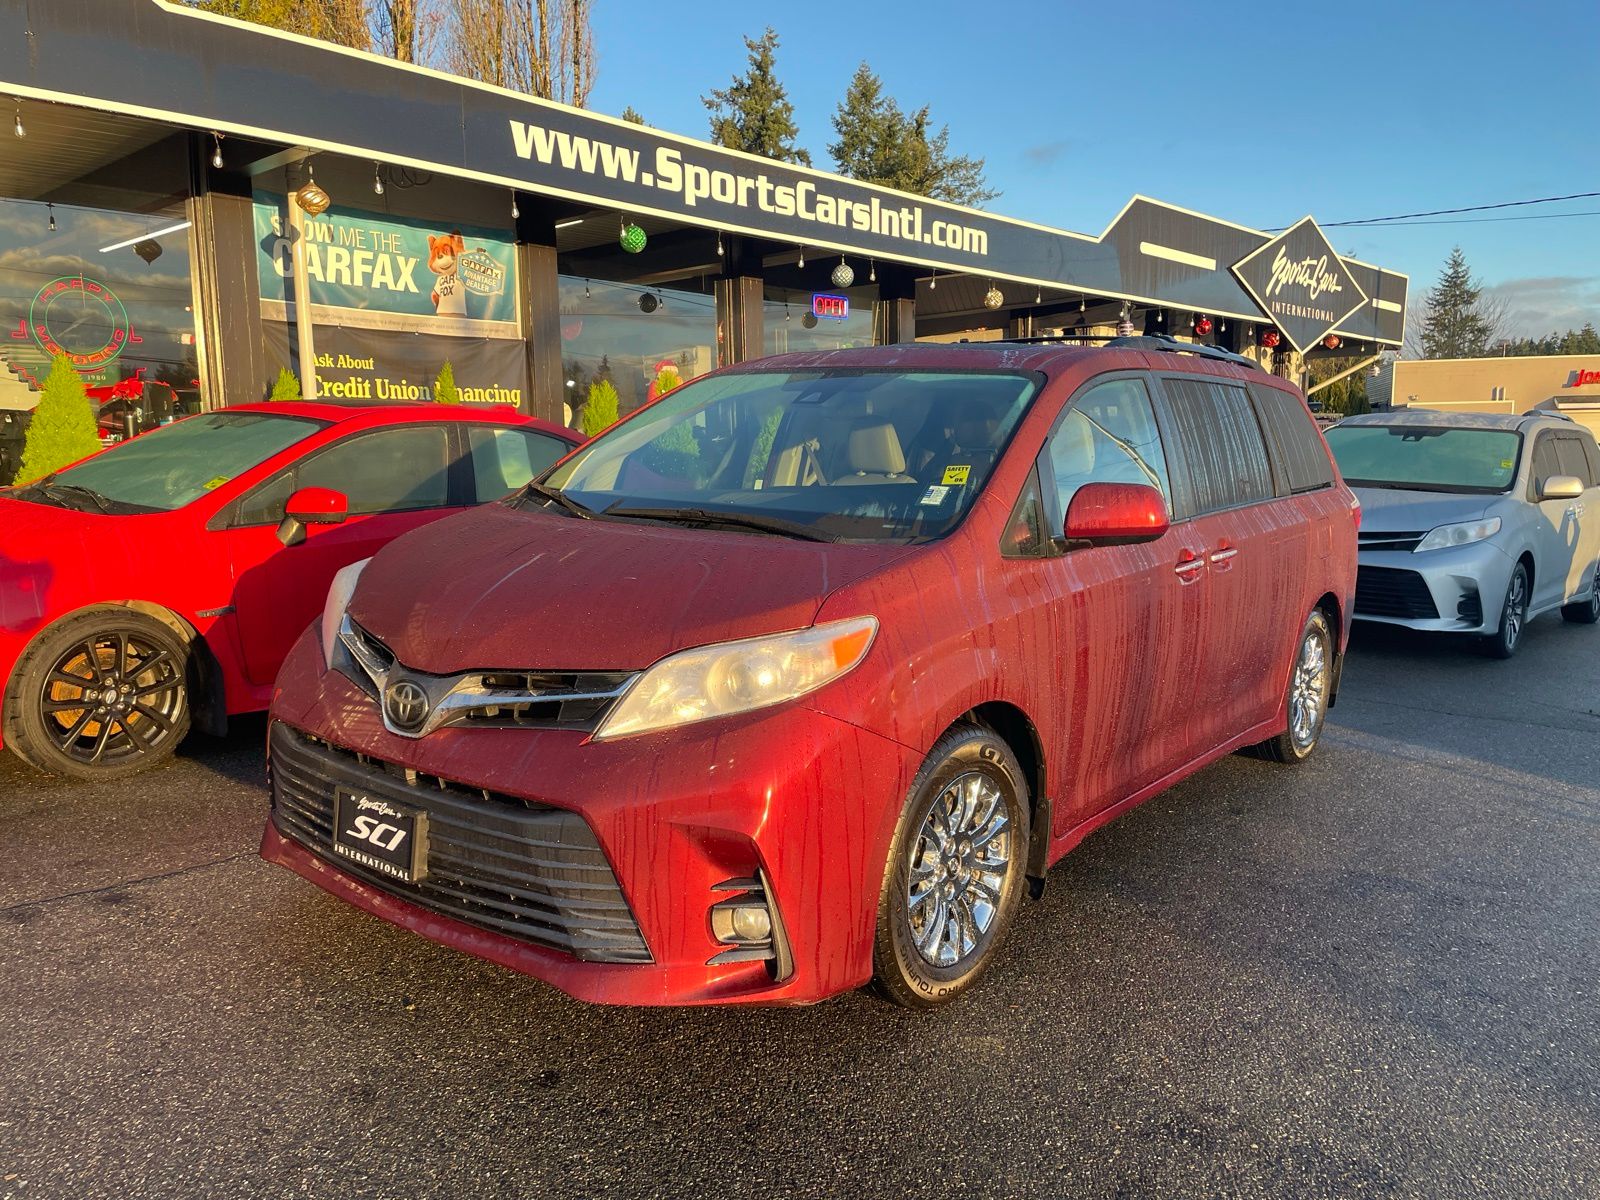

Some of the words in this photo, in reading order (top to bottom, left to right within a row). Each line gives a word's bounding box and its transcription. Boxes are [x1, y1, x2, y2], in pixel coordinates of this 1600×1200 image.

[509, 119, 988, 256] www.SportsCarsIntl.com
[339, 226, 367, 249] ME
[369, 230, 401, 254] THE
[273, 238, 420, 294] CARFAX
[462, 258, 501, 280] CARFAX
[40, 279, 114, 304] HAPPY
[440, 273, 455, 287] CAR
[440, 285, 454, 297] FOX
[466, 279, 490, 293] DEALER
[815, 296, 847, 317] OPEN
[1271, 301, 1335, 323] INTERNATIONAL
[337, 354, 374, 370] About
[315, 374, 371, 399] Credit
[375, 378, 431, 401] Union
[434, 381, 521, 409] nancing
[345, 815, 407, 852] SCI
[333, 843, 410, 882] INTERNATIONAL
